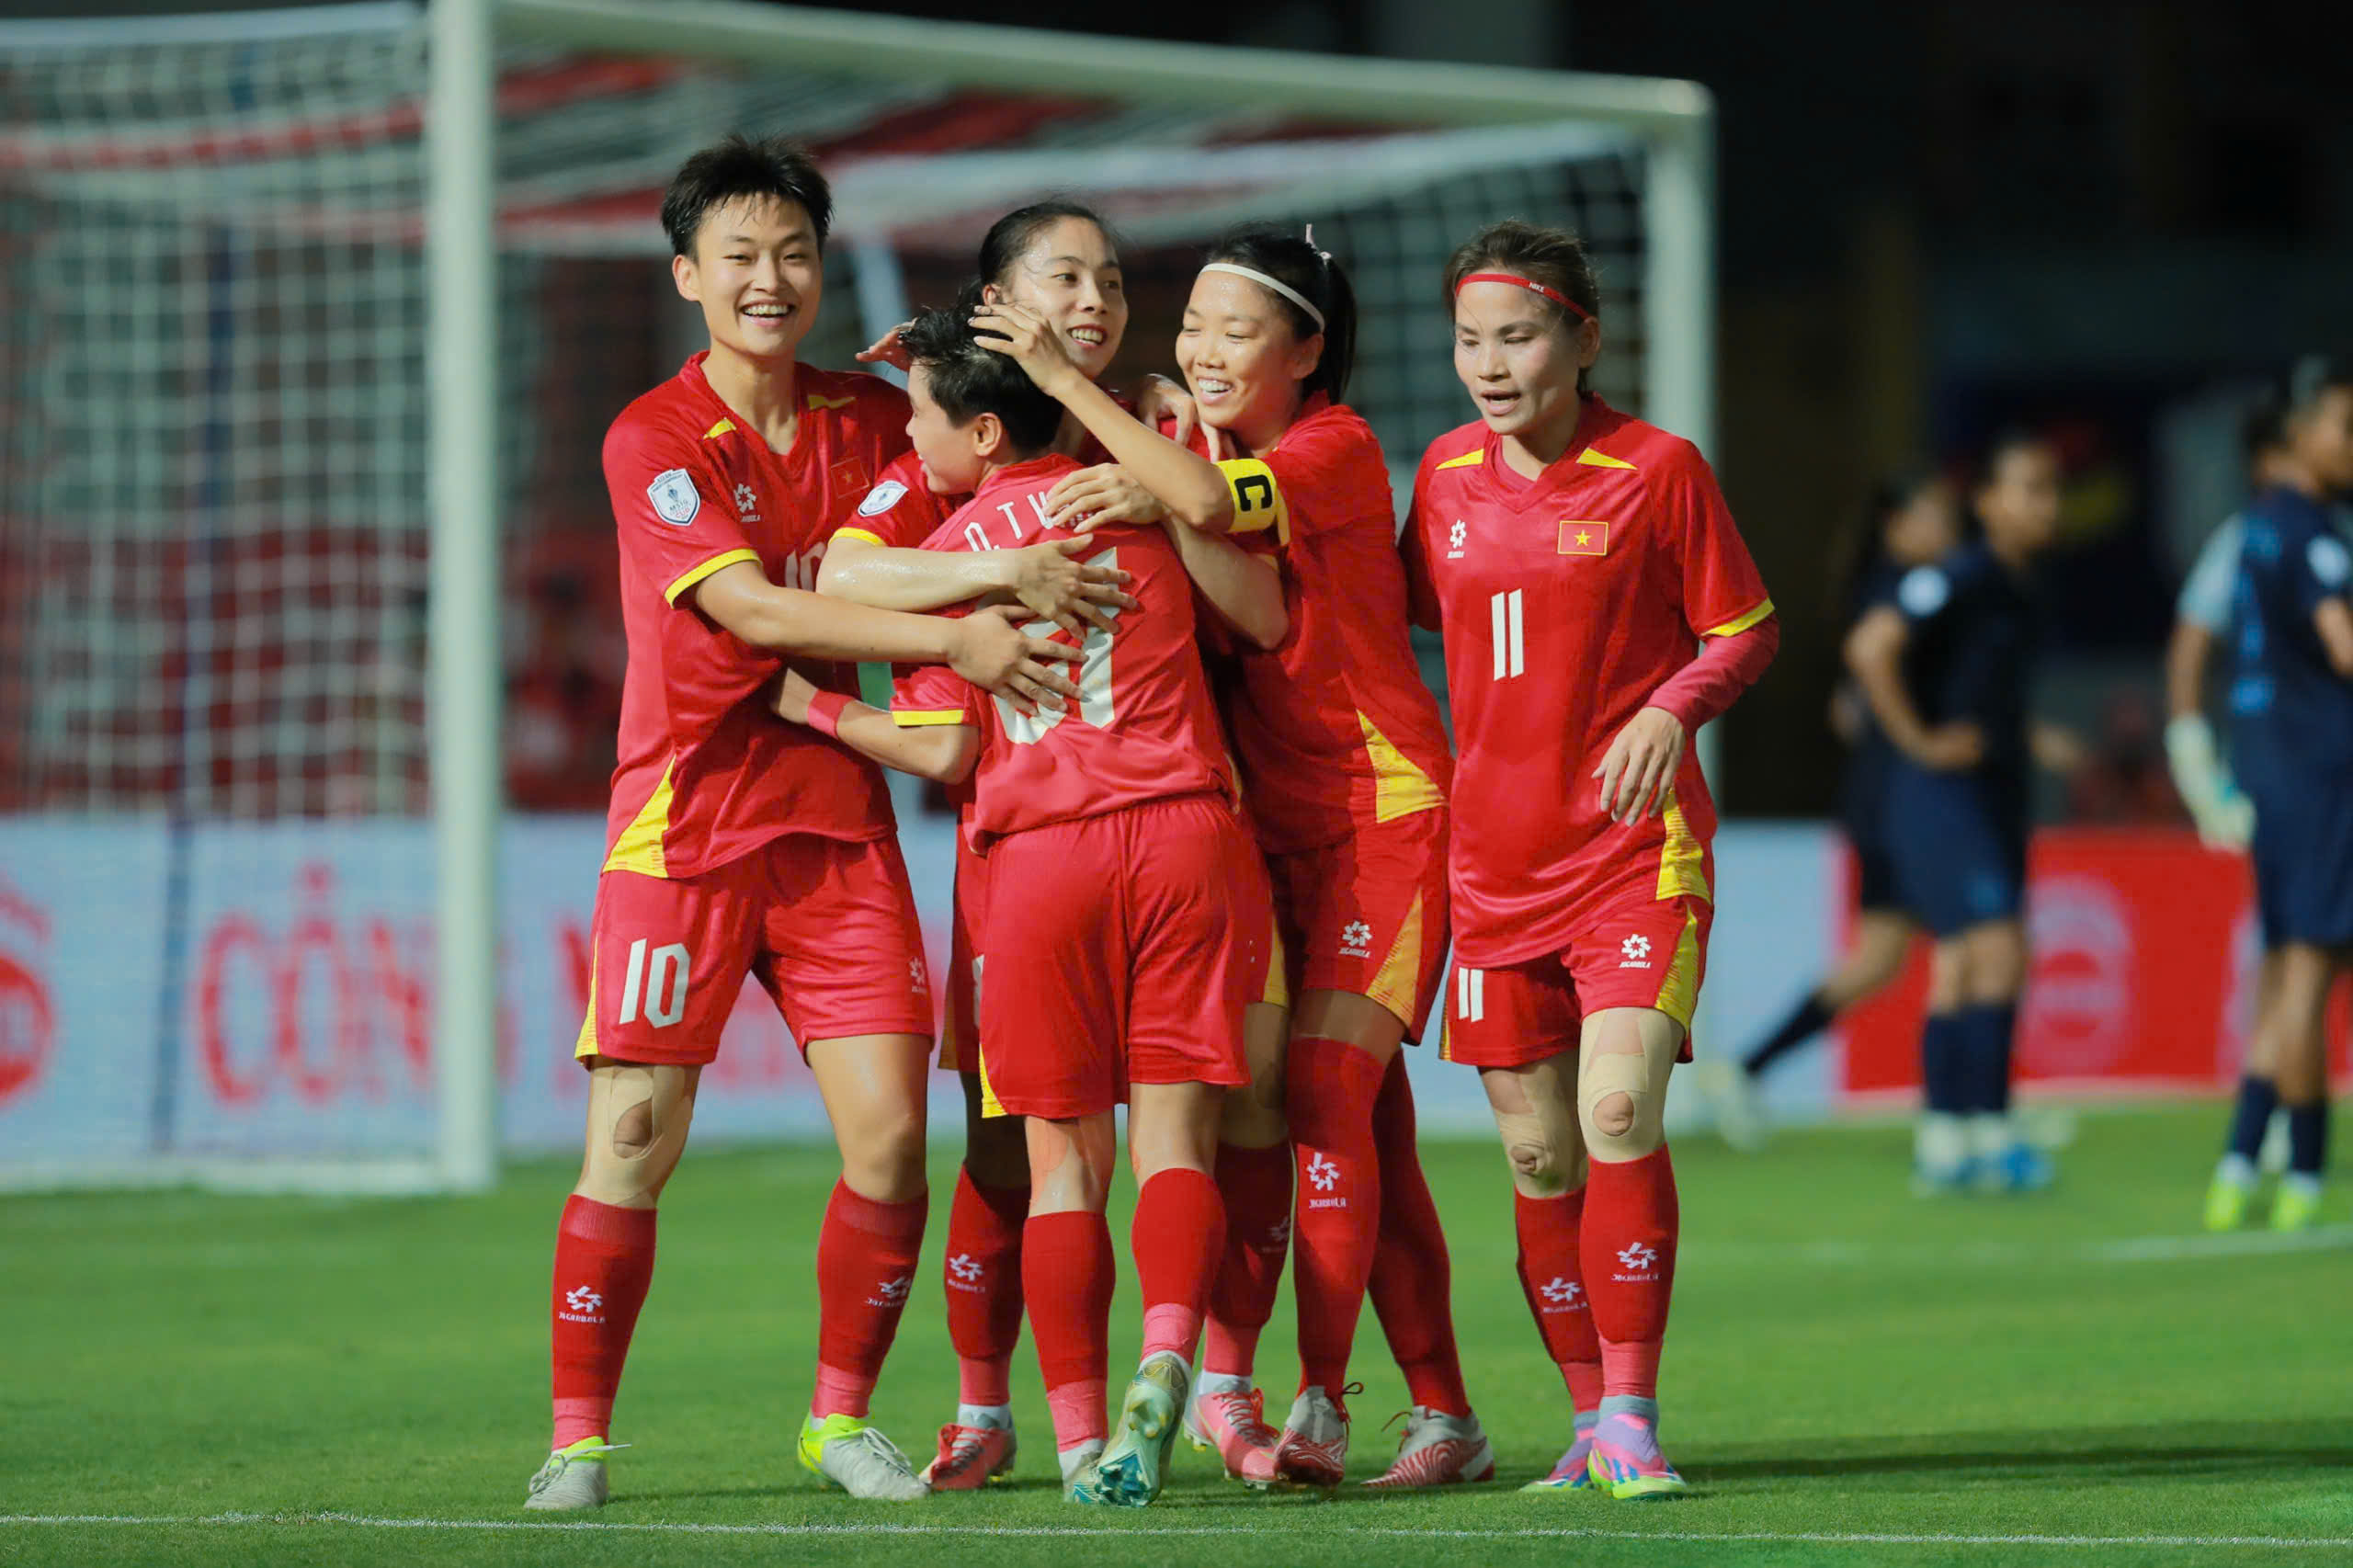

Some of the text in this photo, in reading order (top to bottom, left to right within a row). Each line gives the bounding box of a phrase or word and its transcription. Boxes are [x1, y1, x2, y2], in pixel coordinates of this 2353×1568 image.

[1234, 474, 1273, 512] C
[1490, 587, 1525, 682] 11
[619, 937, 691, 1028] 10
[1458, 966, 1484, 1022] 11
